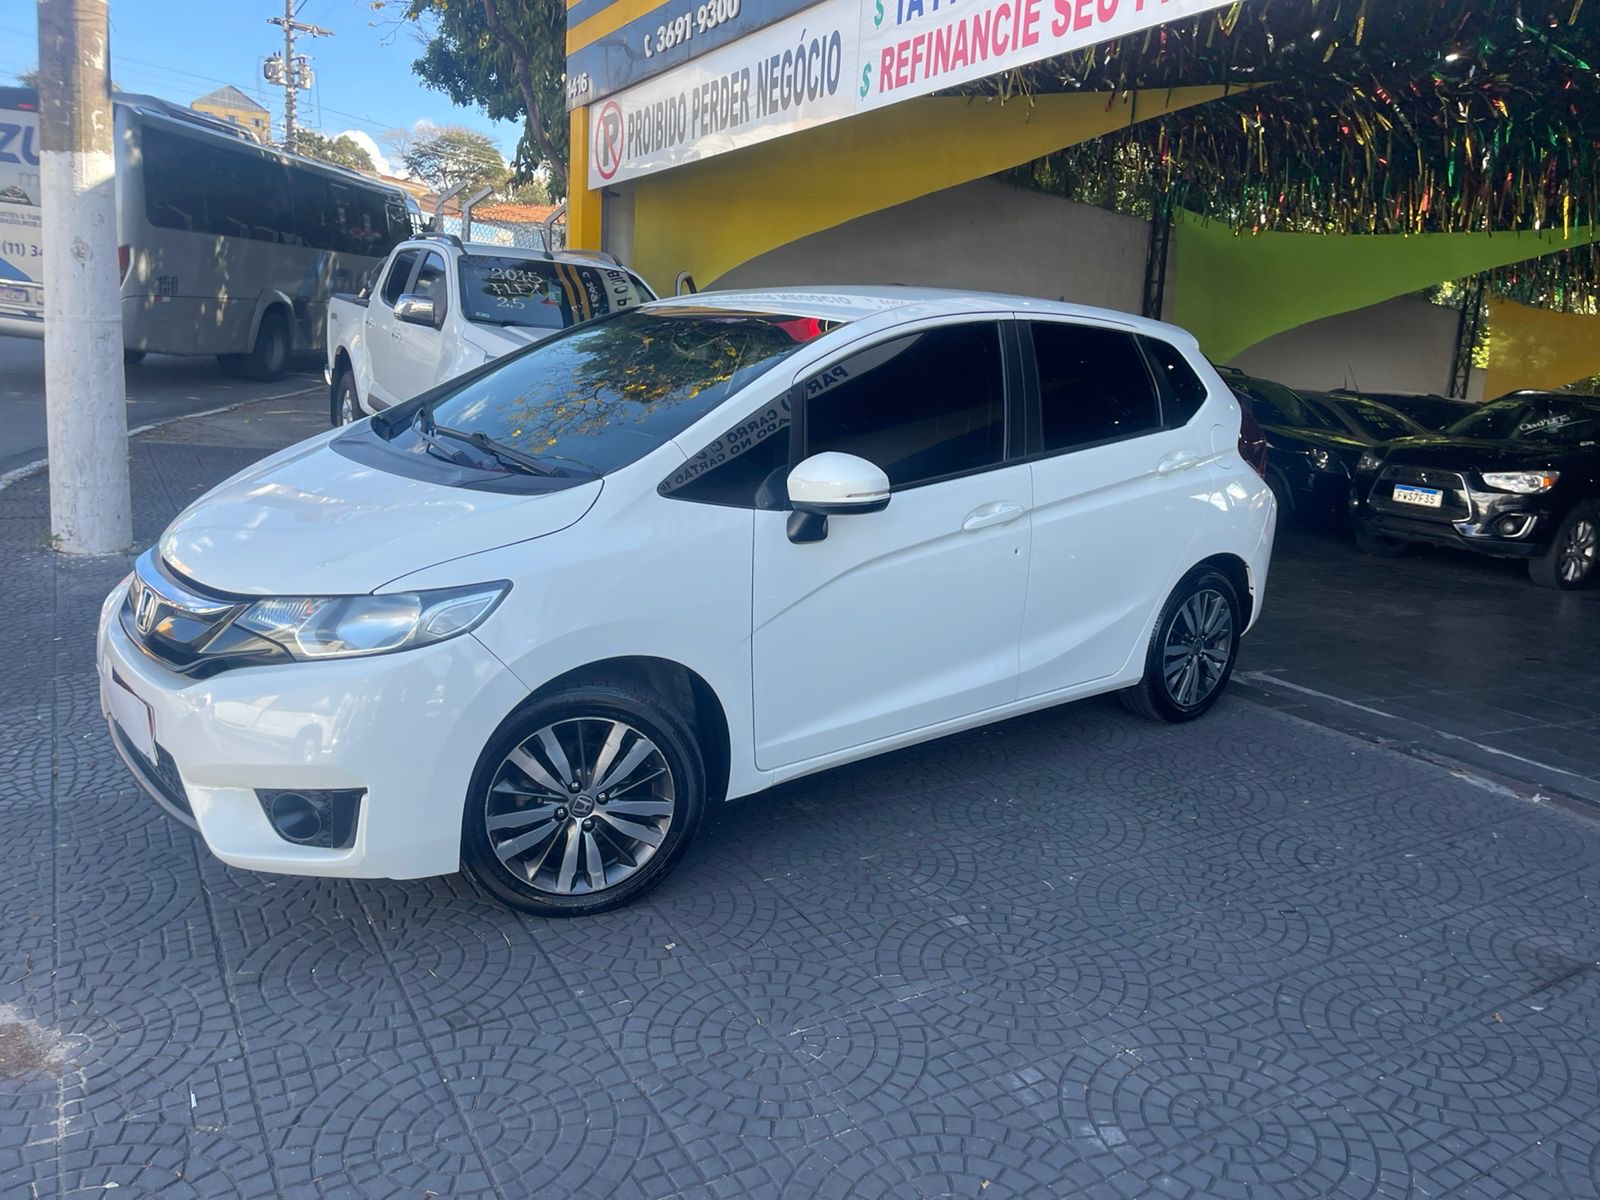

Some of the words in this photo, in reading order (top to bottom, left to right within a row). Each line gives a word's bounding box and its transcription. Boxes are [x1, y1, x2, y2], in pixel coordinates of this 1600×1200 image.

[656, 0, 741, 53] 3691-9300
[879, 0, 1045, 93] REFINANCIE
[627, 92, 687, 161] PROIBIDO
[692, 66, 751, 140] PERDER
[756, 28, 842, 119] NEGÓCIO
[490, 267, 543, 284] 2015
[490, 282, 543, 297] FLEX
[496, 296, 526, 310] 2.5
